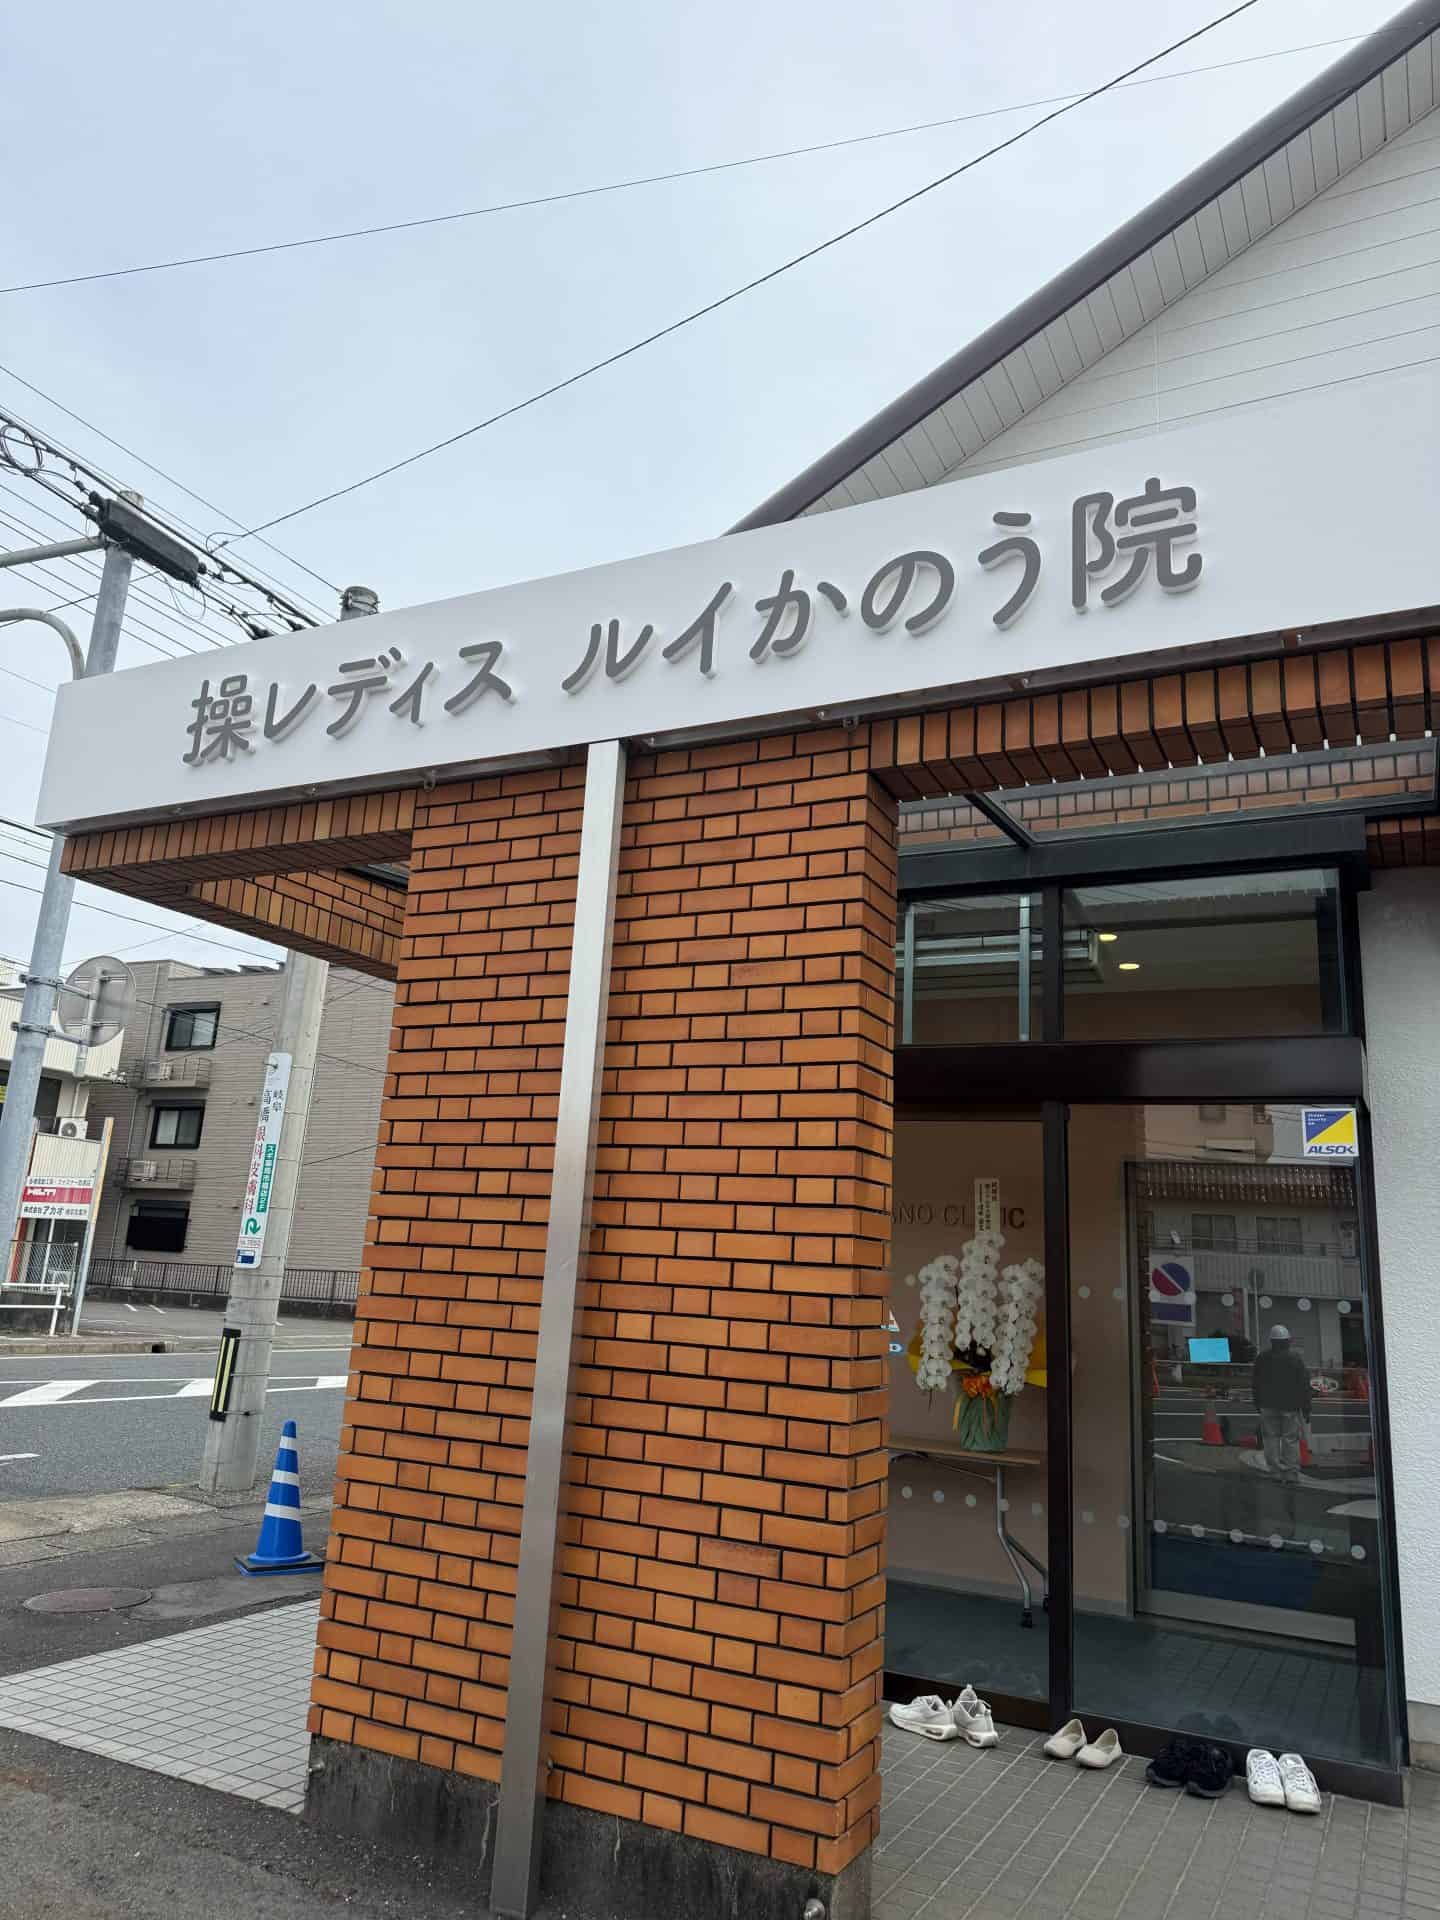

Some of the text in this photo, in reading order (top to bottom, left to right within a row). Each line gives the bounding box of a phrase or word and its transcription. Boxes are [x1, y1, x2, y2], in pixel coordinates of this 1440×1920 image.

[183, 477, 1203, 763] 操レディス ルイかのう院
[1307, 1145, 1355, 1155] ALSOK
[943, 1204, 1025, 1229] CLIC
